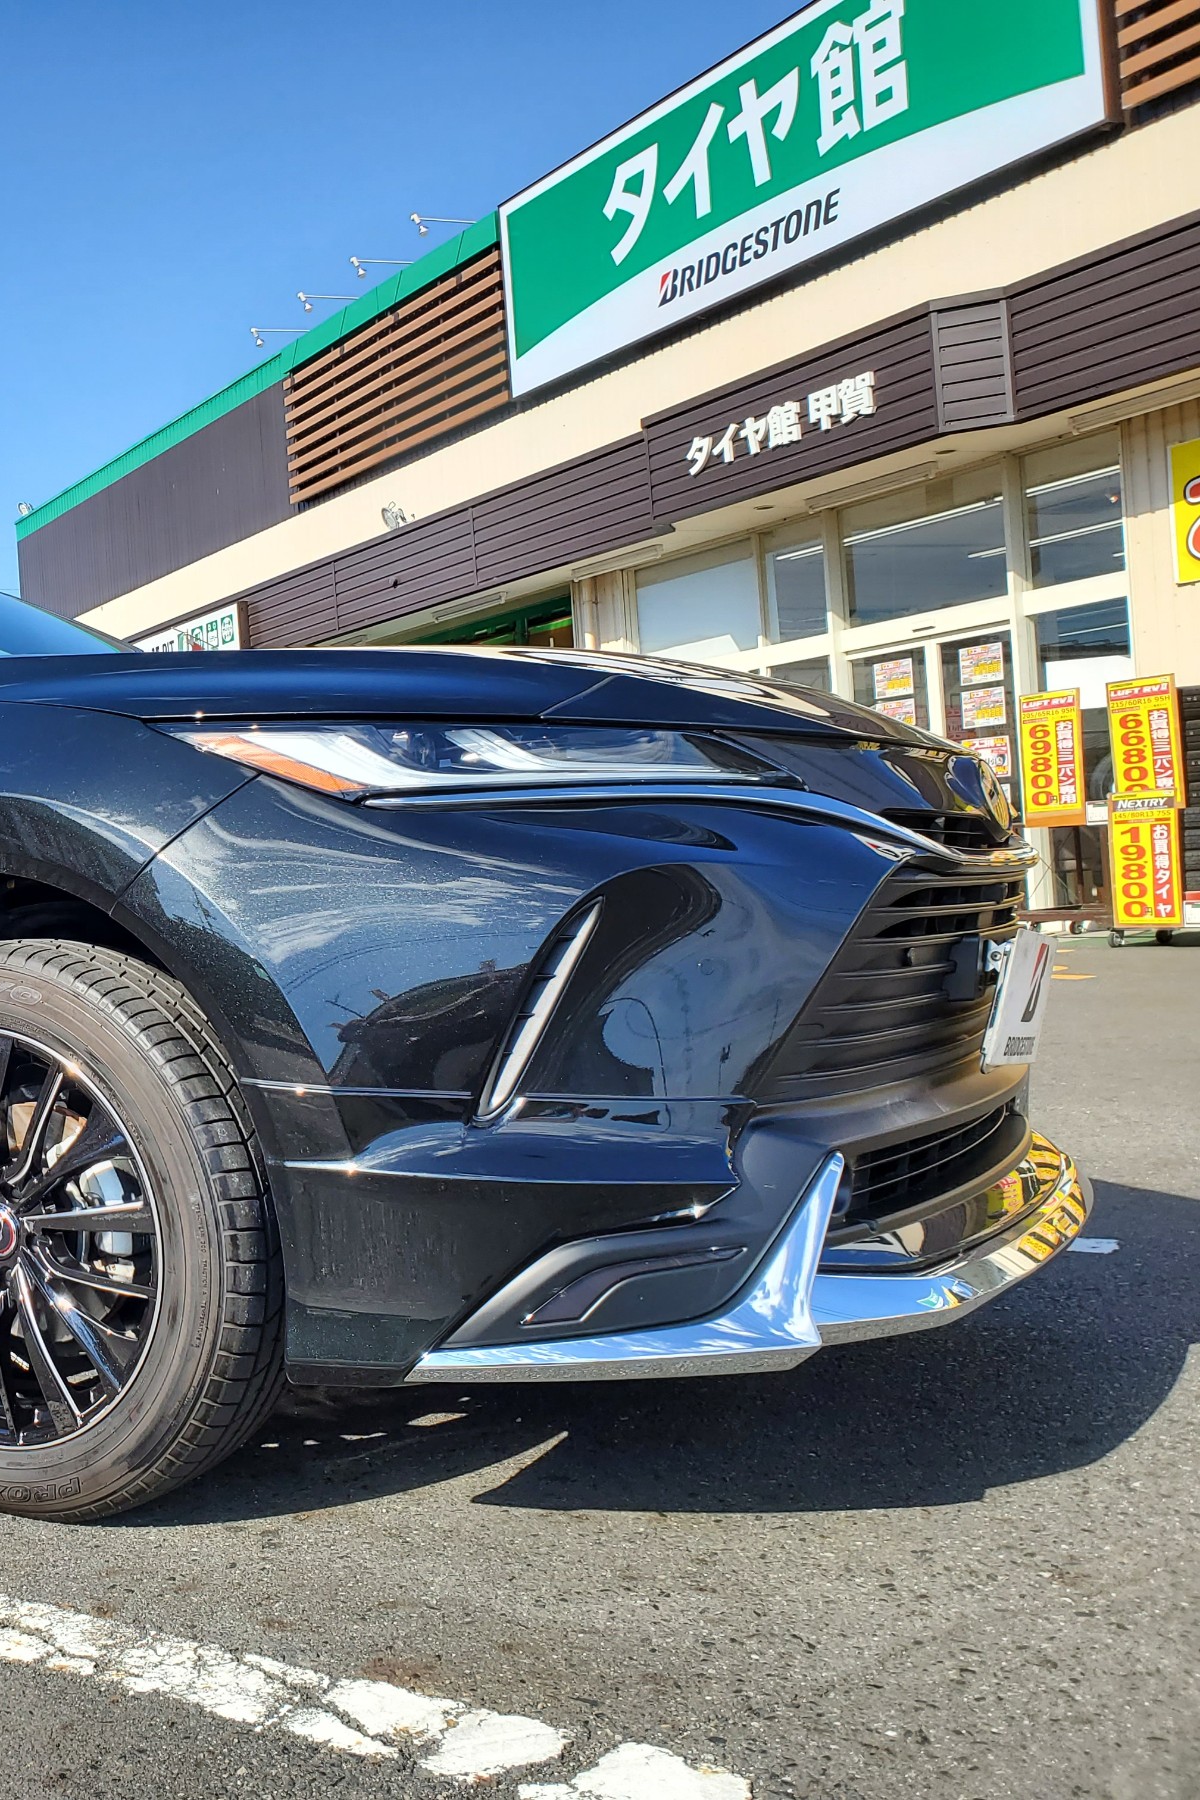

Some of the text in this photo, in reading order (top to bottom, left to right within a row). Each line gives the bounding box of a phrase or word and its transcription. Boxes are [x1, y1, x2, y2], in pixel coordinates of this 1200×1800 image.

[602, 0, 909, 267] タイヤ館
[657, 188, 841, 308] BRIDGESTONE
[685, 371, 877, 476] タイヤ館 甲賀
[1110, 699, 1153, 709] 215/60R16
[1114, 811, 1154, 820] 145/80R13
[1117, 797, 1167, 809] NEXTRY
[1152, 824, 1173, 918] お買得タイヤ
